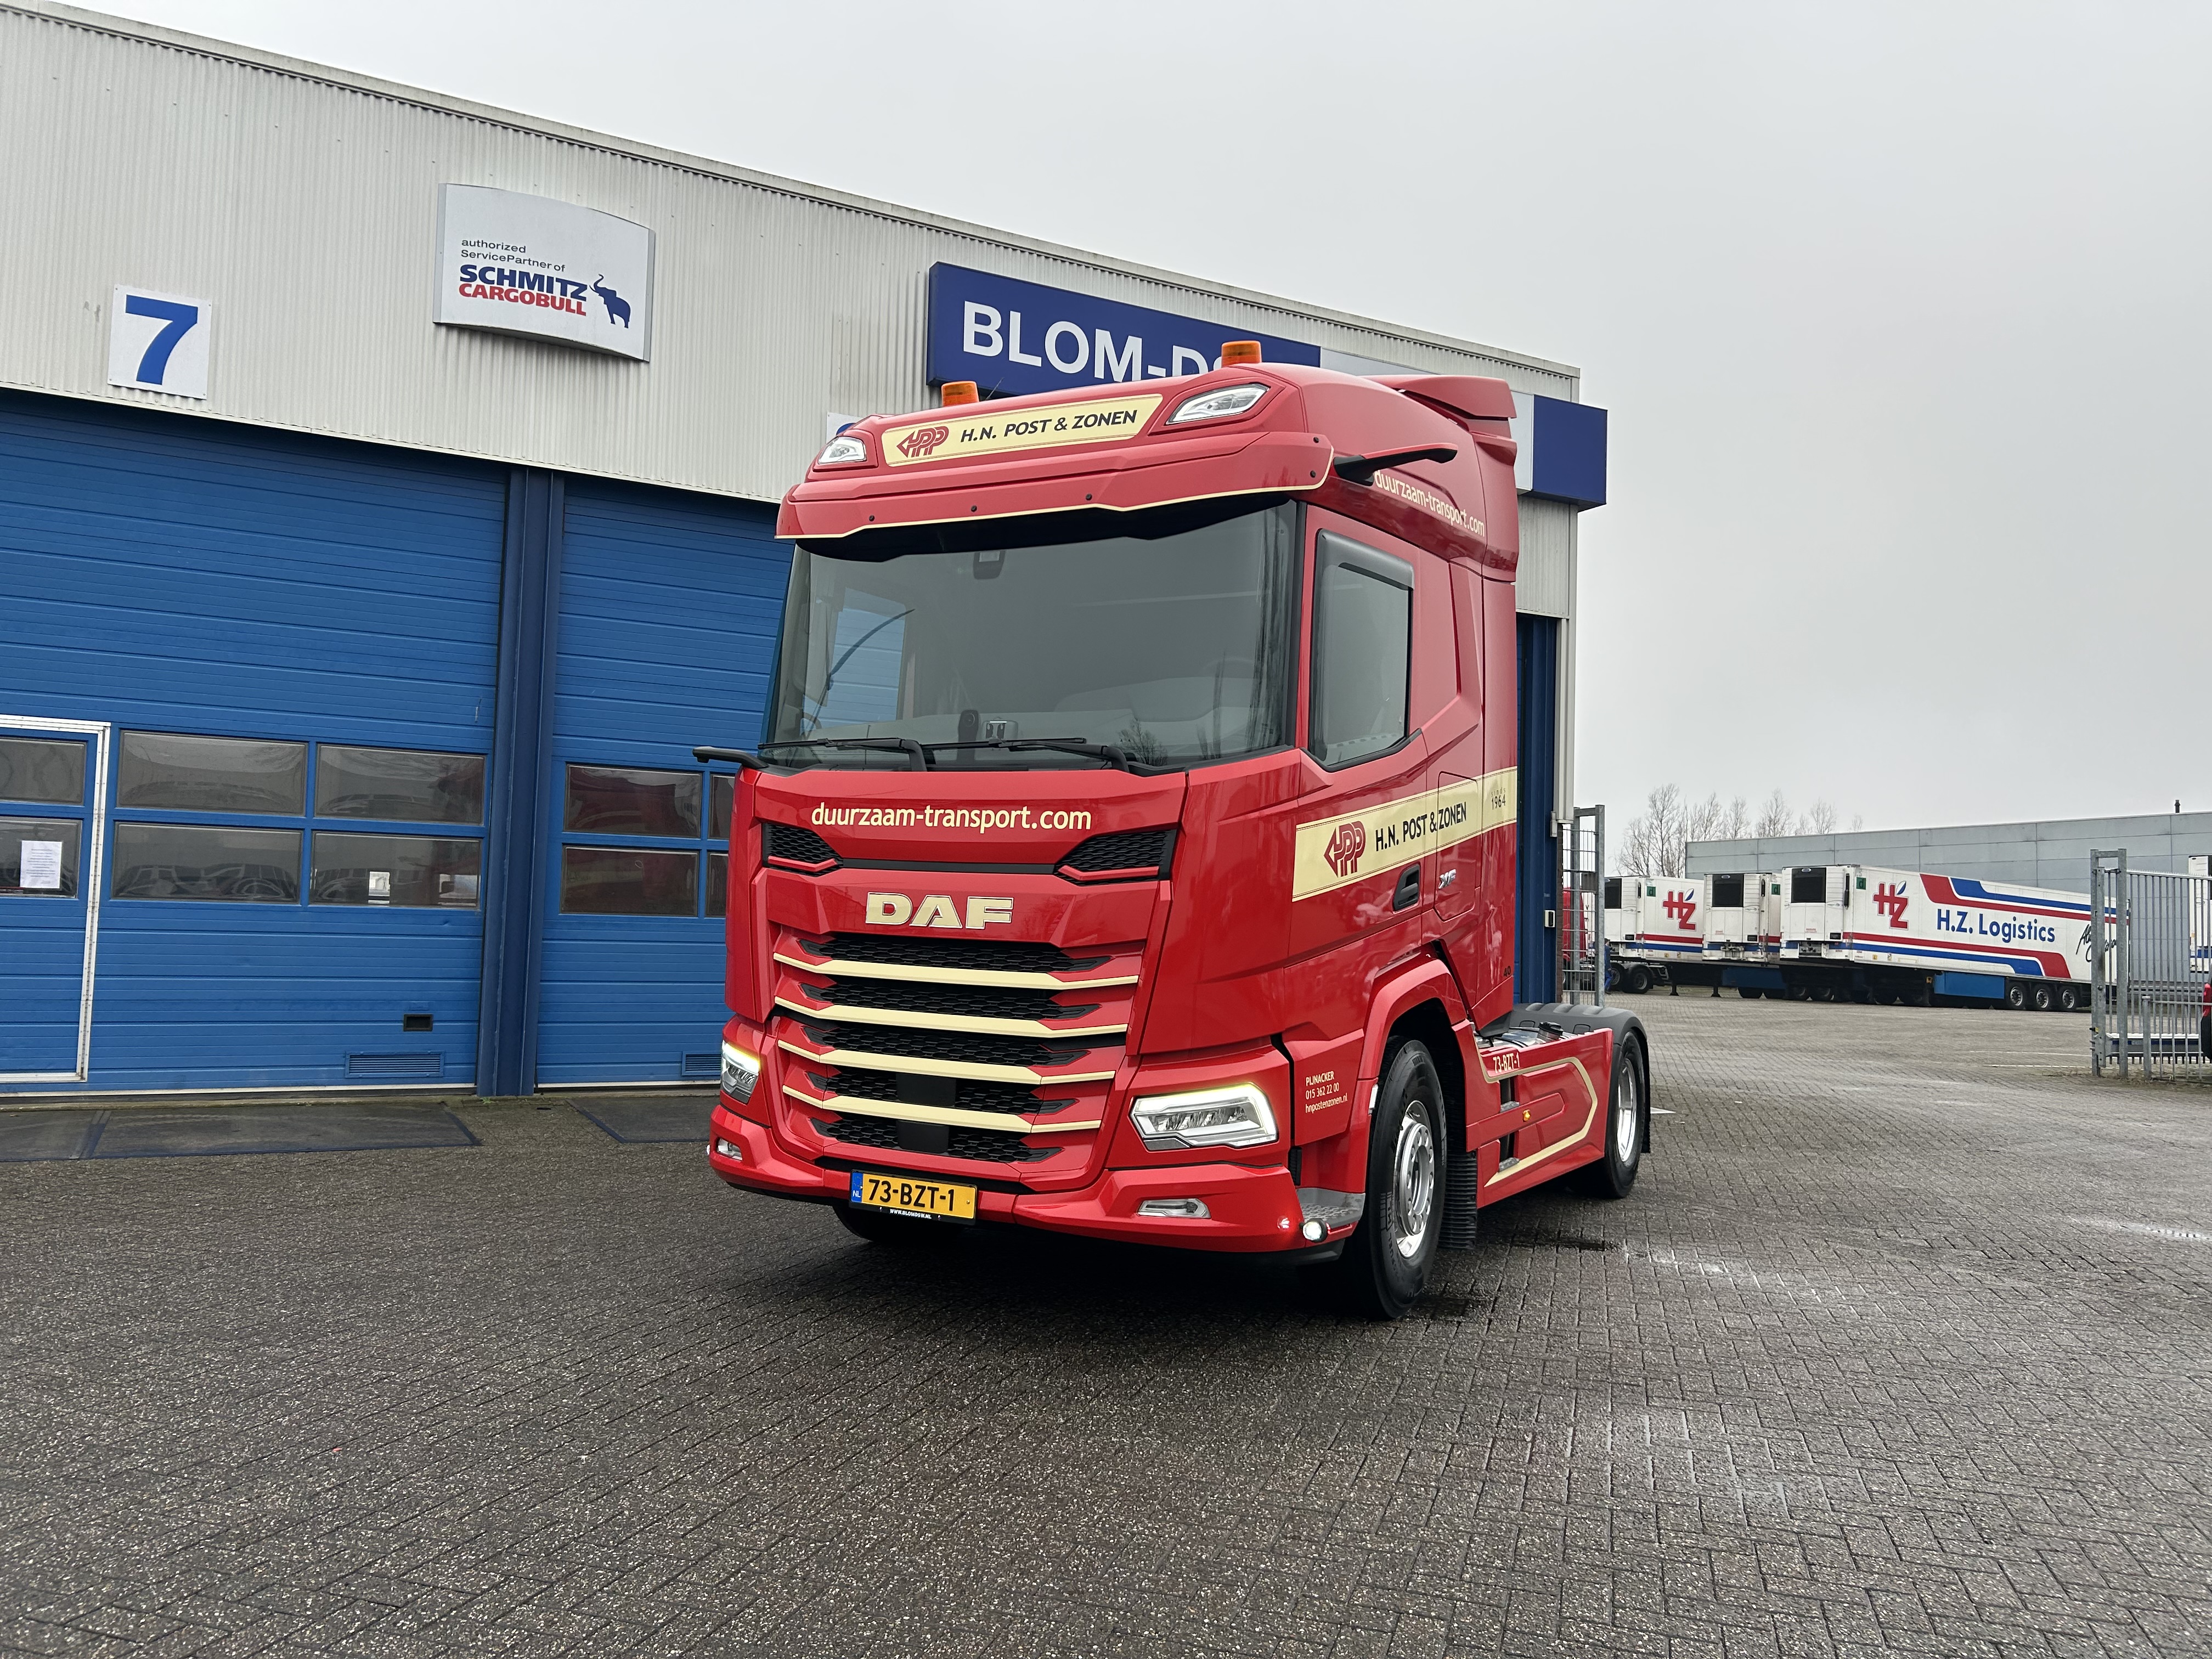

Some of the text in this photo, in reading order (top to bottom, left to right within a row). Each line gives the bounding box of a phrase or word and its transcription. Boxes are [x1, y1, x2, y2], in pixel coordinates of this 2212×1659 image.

[461, 238, 526, 253] authorized
[461, 249, 566, 272] ServicePartner of
[459, 264, 588, 302] SCHMITZ
[459, 283, 586, 317] CARGOBULL
[125, 294, 199, 385] 7
[963, 300, 1222, 382] BLOM-D
[961, 426, 997, 443] H.N.
[1004, 419, 1052, 437] POST
[1054, 417, 1068, 431] &
[1071, 409, 1137, 430] ZONEN
[1374, 470, 1485, 537] duurzaam-transport.com
[811, 802, 1091, 833] duurzaam-transport.com
[1492, 794, 1505, 810] 1964
[1375, 824, 1399, 851] H.N.
[1403, 814, 1427, 842] POST
[1430, 811, 1437, 833] &
[1438, 802, 1466, 830] ZONEN
[865, 892, 1014, 929] DAF
[1937, 909, 2055, 943] H.Z. Logistics
[1306, 1070, 1335, 1086] PIJNACKER
[1493, 1052, 1520, 1074] 73-BZT-1
[1305, 1092, 1348, 1114] hnpostenzonen.nl
[1306, 1082, 1339, 1100] 015 362 22 00
[868, 1178, 955, 1211] 73-BZT-1
